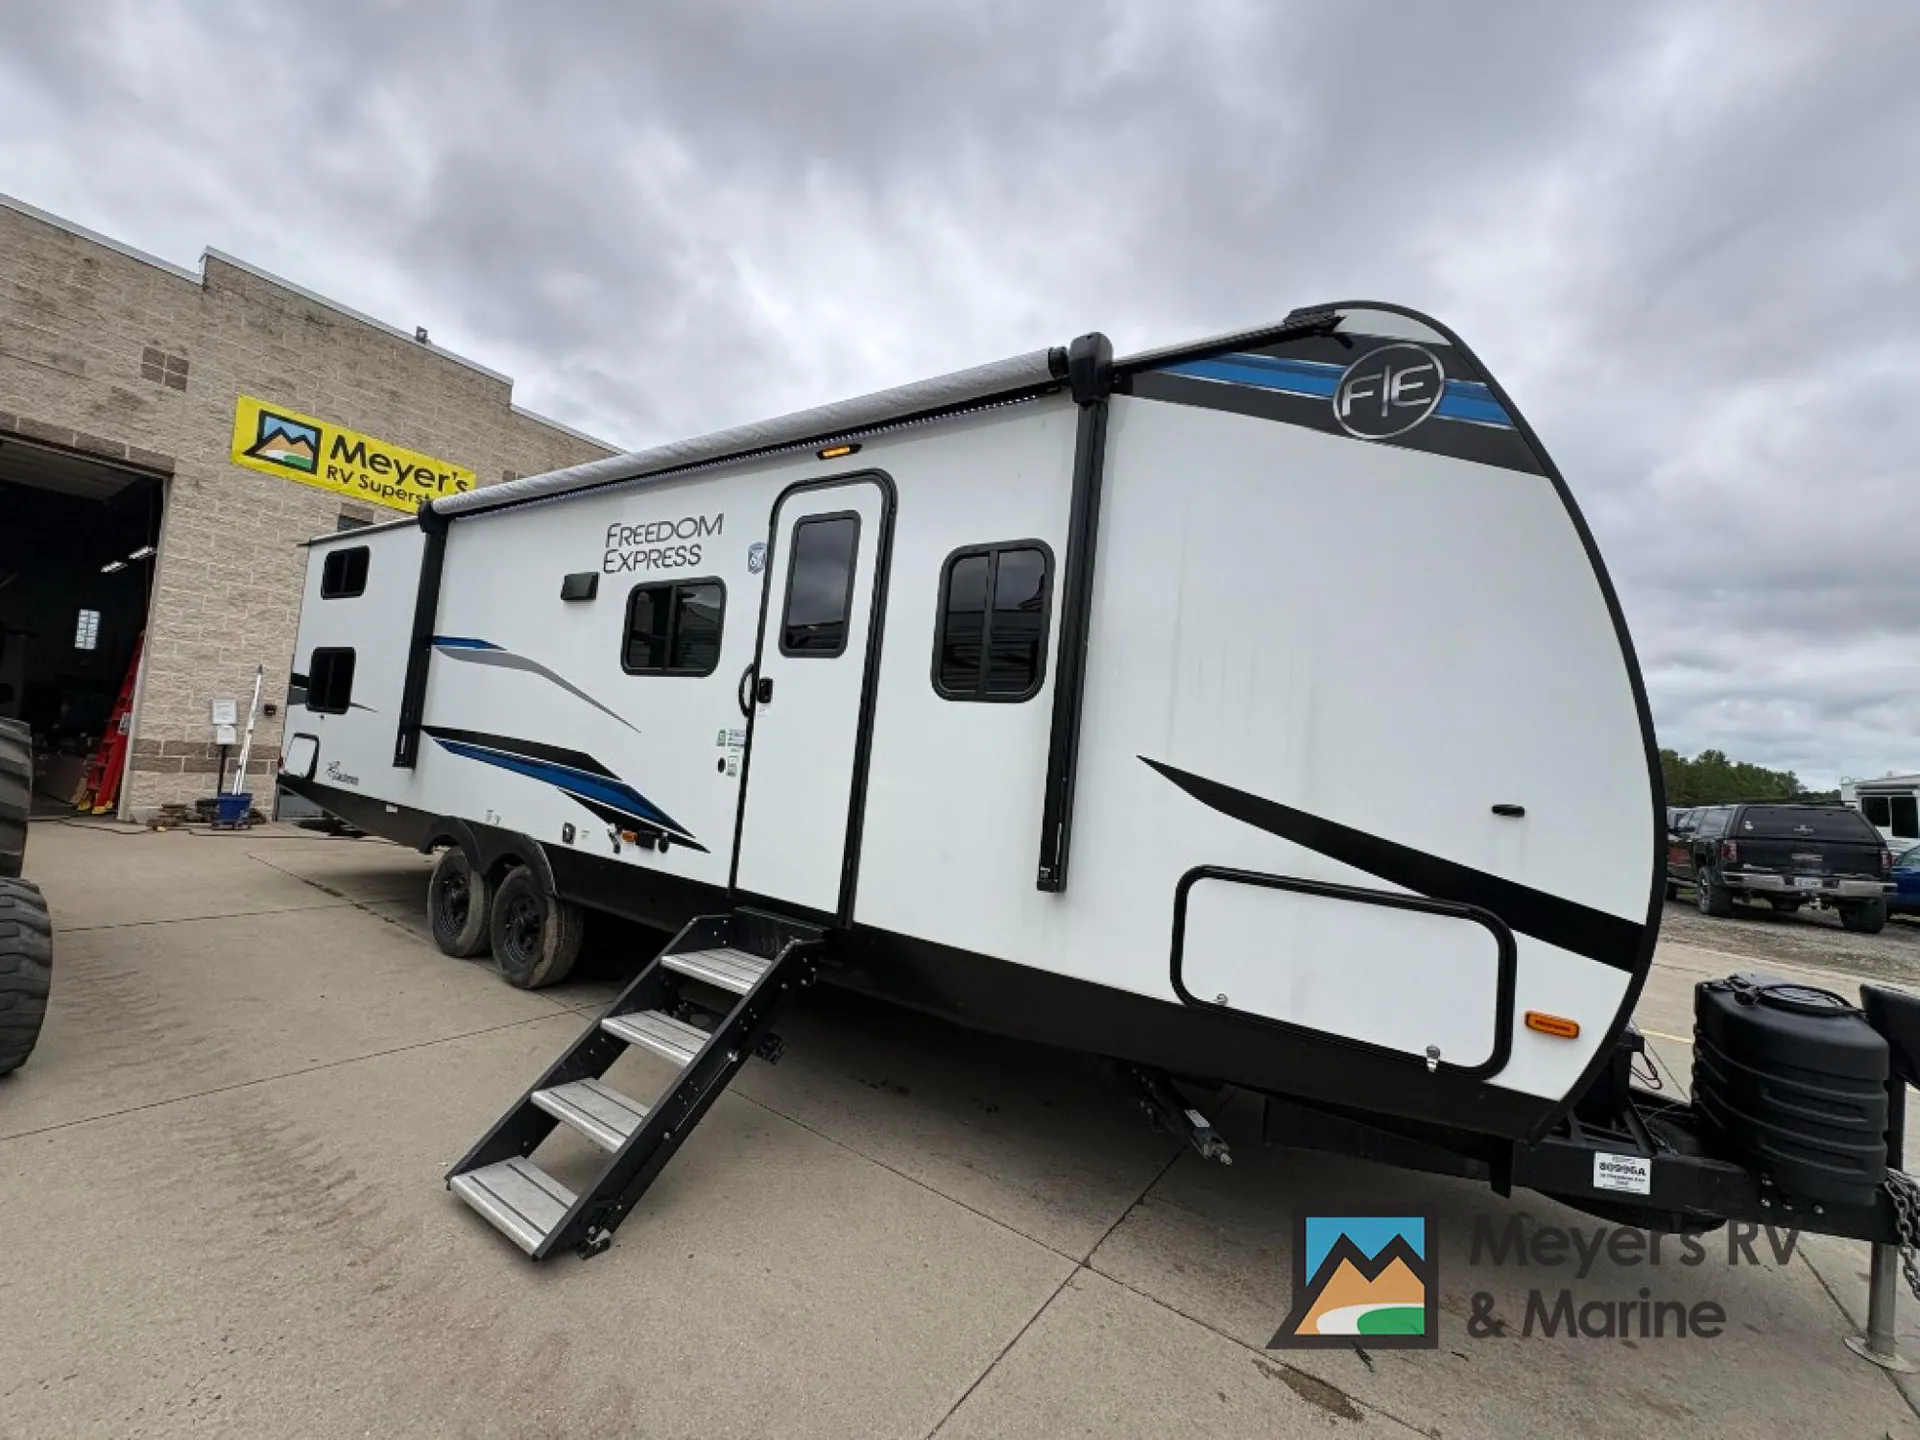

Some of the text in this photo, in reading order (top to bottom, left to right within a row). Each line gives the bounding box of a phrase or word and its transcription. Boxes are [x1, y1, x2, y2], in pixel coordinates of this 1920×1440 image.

[330, 434, 469, 494] Meyer's
[326, 465, 431, 505] RV Superst
[605, 513, 724, 548] FREEDOM
[603, 543, 702, 574] EXPRESS
